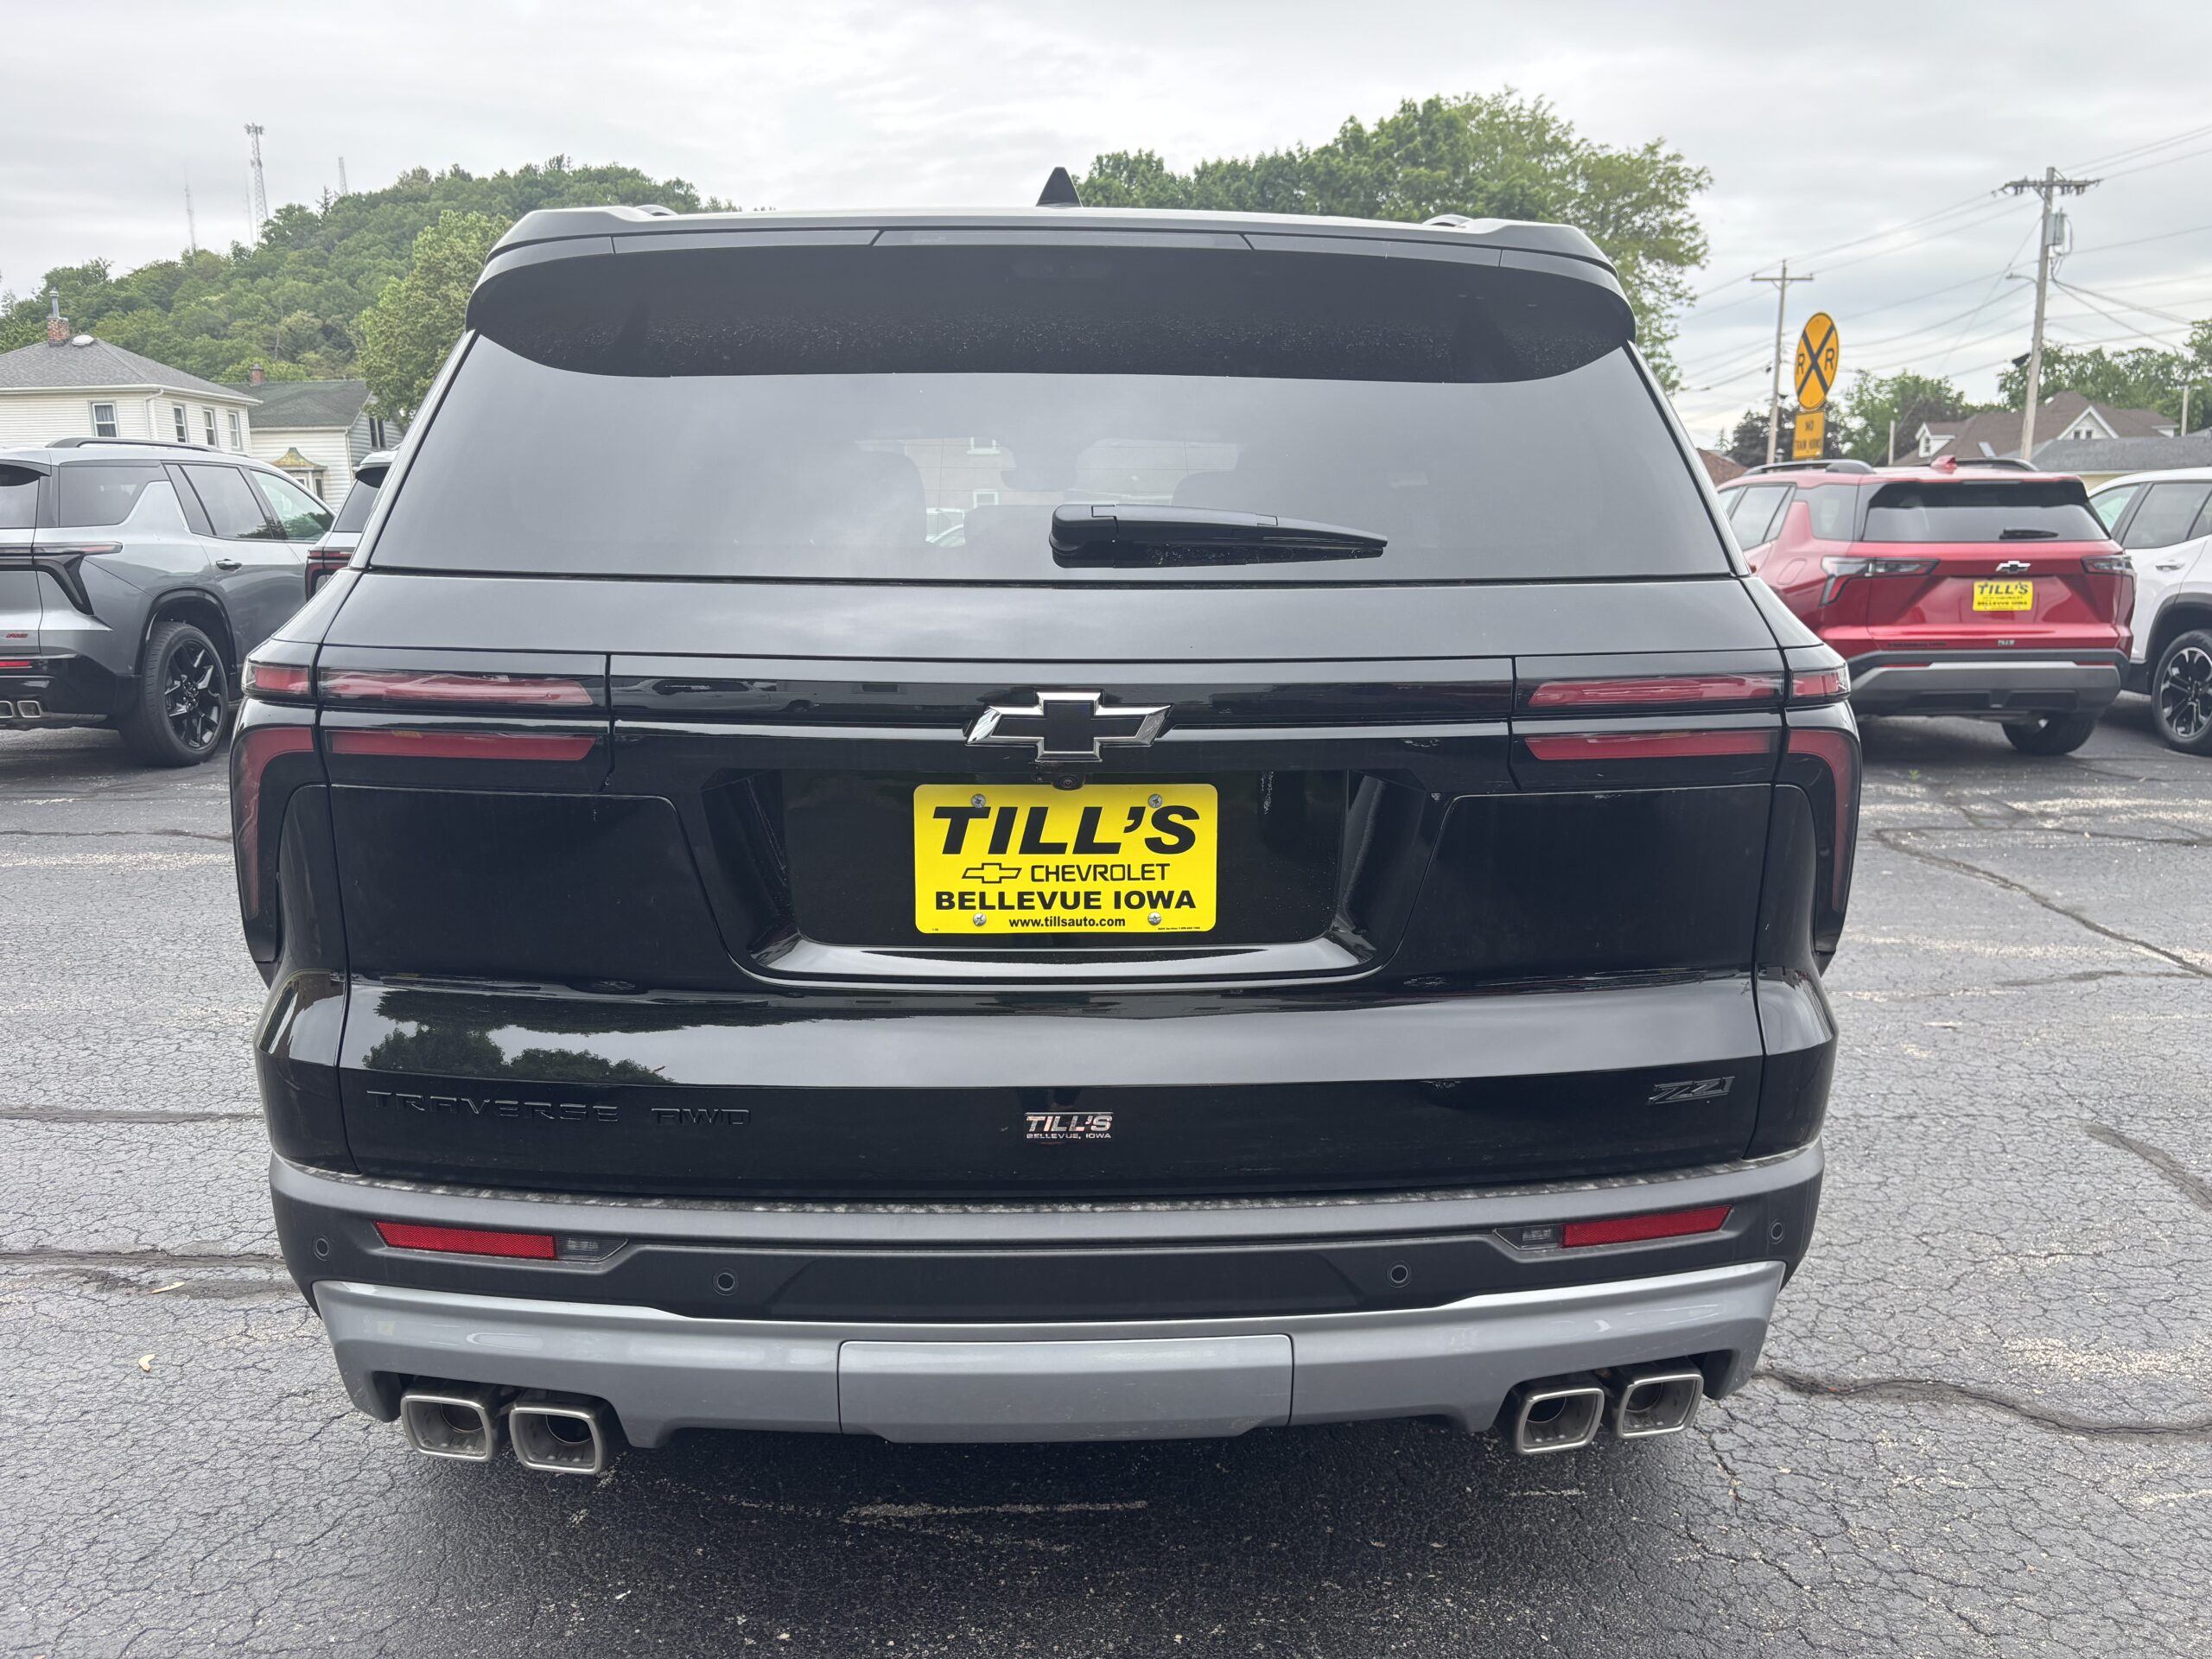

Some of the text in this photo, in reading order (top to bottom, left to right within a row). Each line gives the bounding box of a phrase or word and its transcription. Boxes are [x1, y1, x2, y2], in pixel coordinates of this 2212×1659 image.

[1796, 347, 1836, 376] R R
[1977, 583, 2029, 595] TILL'S
[932, 804, 1200, 855] TILL'S
[1031, 863, 1171, 882] CHEVROLET
[935, 890, 1197, 910] BELLEVUE IOWA
[1008, 915, 1126, 928] www.tillsauto.com
[366, 1090, 751, 1125] TRAVERSE AWD
[1026, 1115, 1113, 1132] TILL'S
